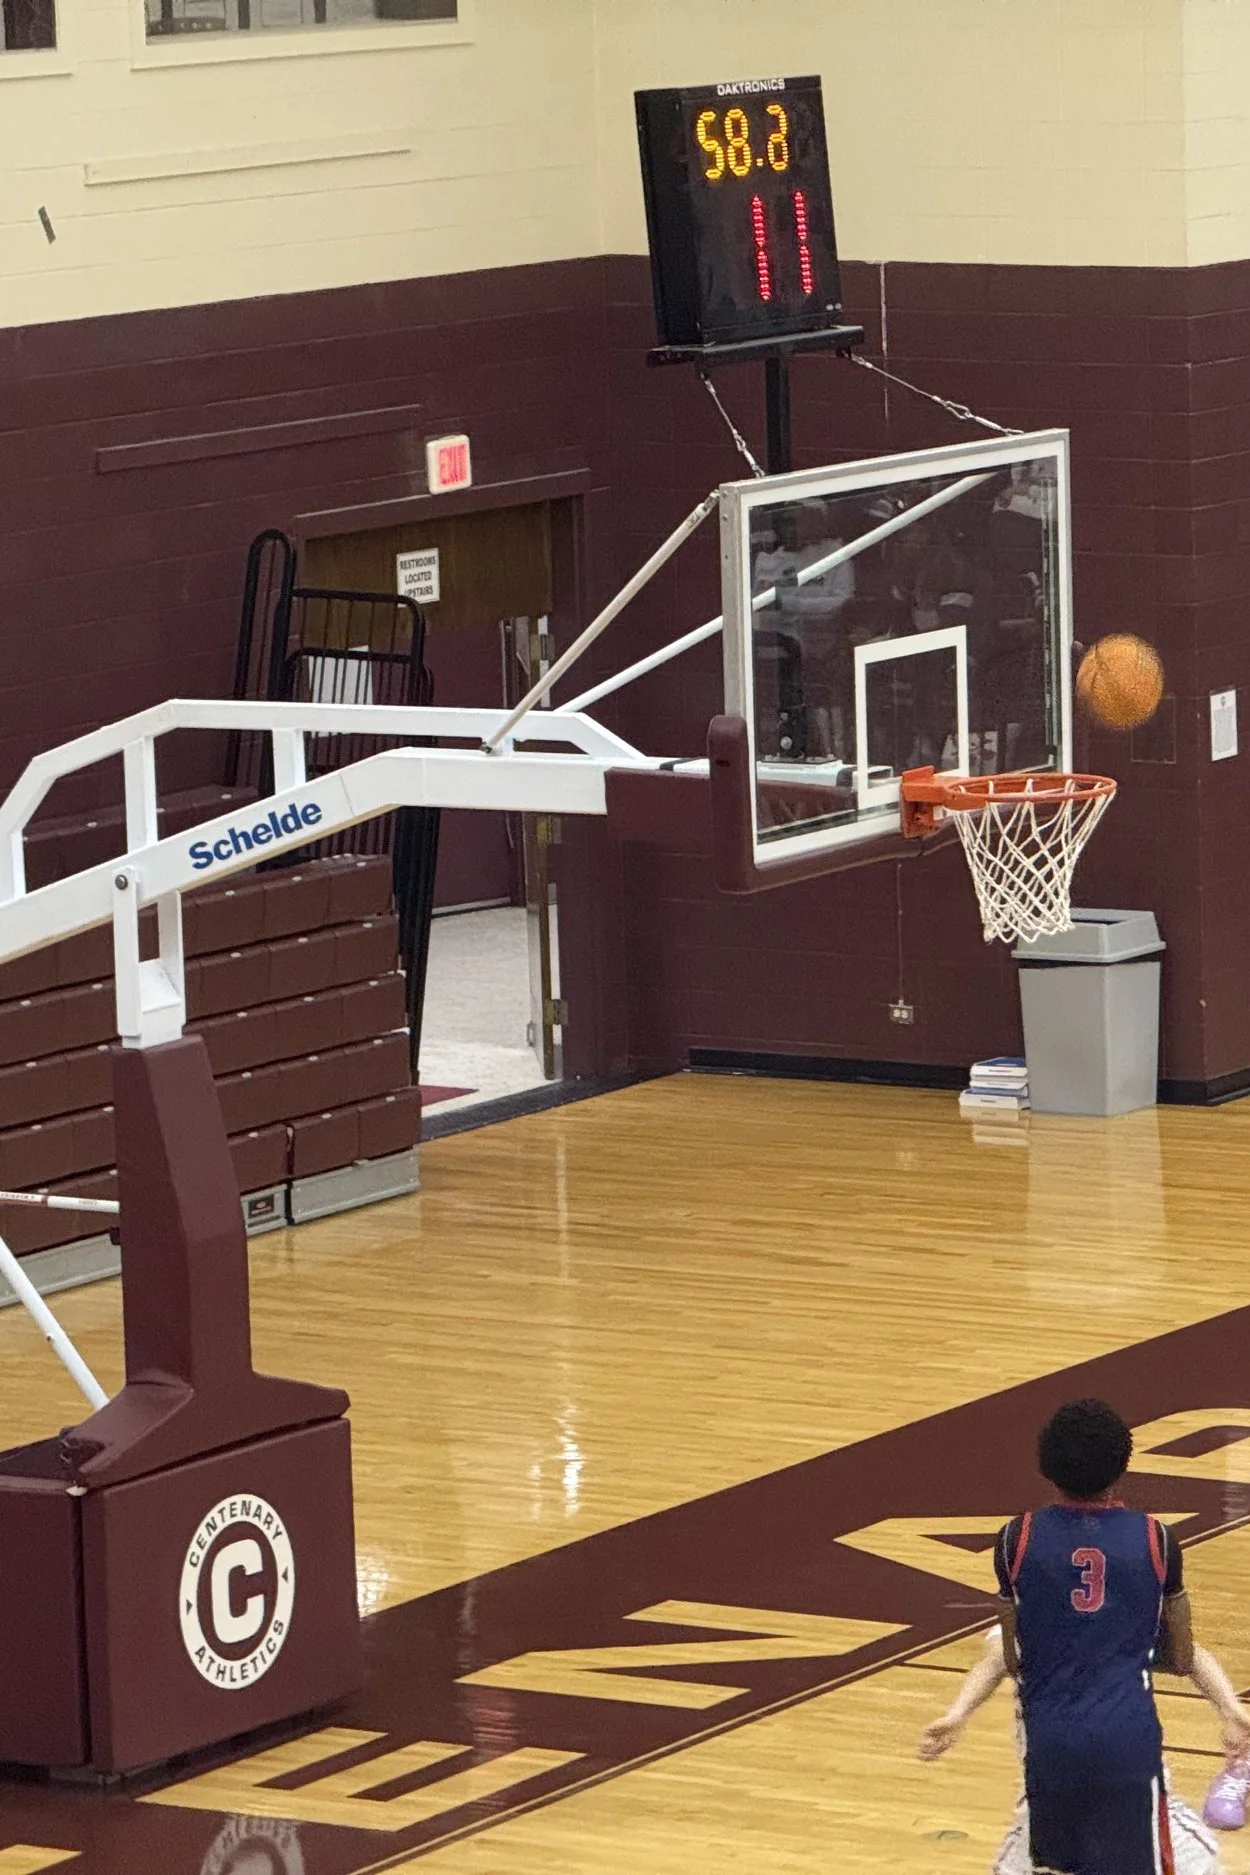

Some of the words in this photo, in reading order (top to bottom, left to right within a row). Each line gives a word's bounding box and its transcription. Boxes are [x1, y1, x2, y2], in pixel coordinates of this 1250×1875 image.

[716, 78, 786, 96] DAKTRONICS
[751, 190, 814, 303] 11
[400, 555, 436, 570] RESTROOMS
[404, 571, 432, 585] LOCATED
[188, 803, 323, 870] Schelde
[189, 1500, 284, 1568] CENTENARY
[211, 1538, 265, 1644] C
[1071, 1548, 1106, 1612] 3
[194, 1619, 285, 1683] ATHLETICS
